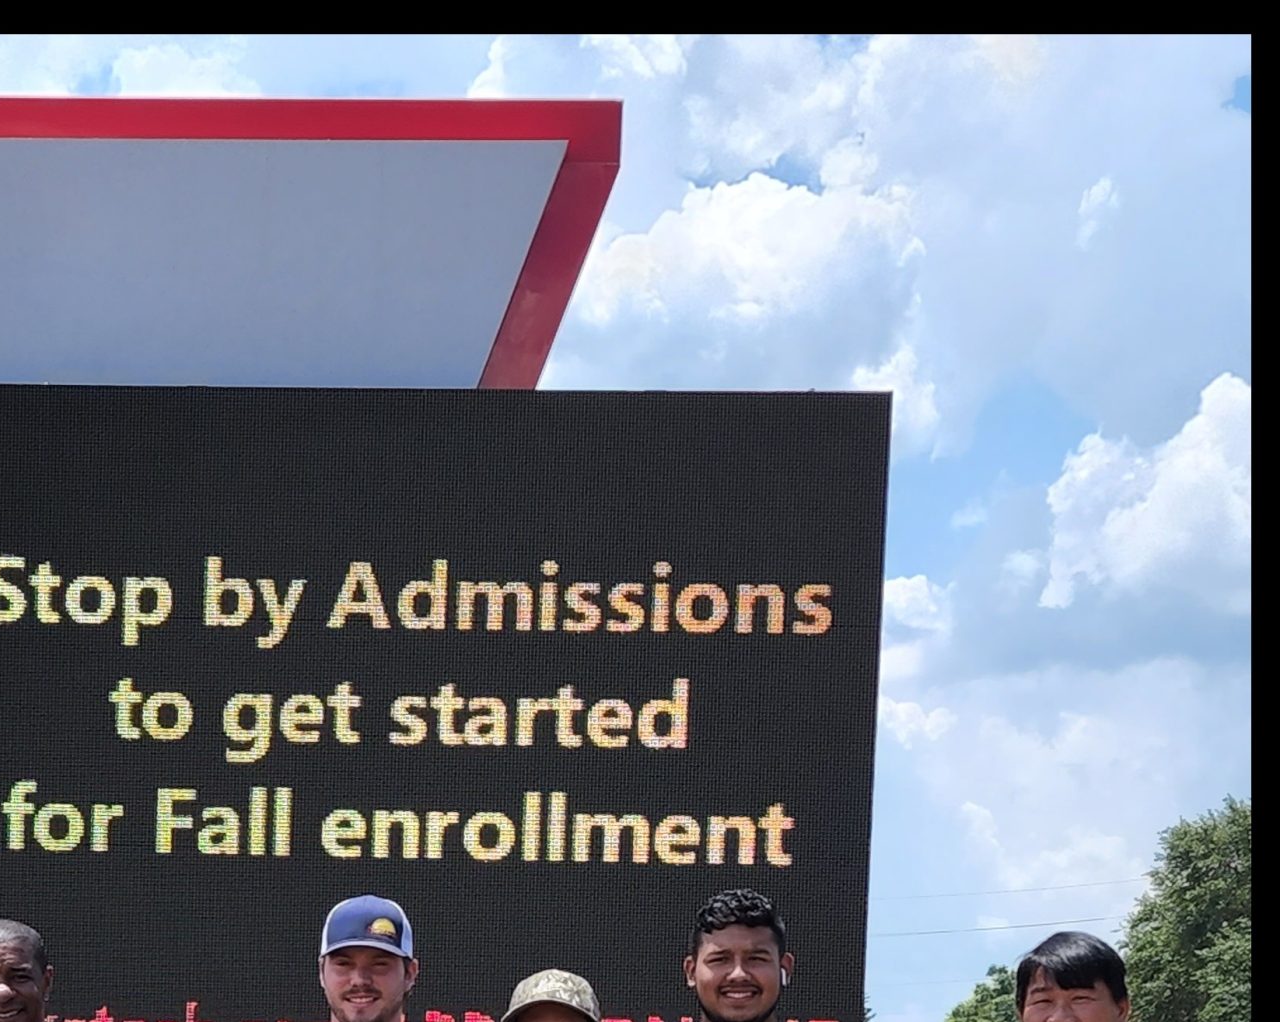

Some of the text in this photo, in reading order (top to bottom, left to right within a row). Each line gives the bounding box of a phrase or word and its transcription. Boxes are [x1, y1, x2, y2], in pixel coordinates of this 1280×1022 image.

[204, 556, 307, 648] by
[327, 559, 832, 636] Admissions
[109, 677, 689, 762] to get started
[2, 781, 794, 867] for Fall enrollment
